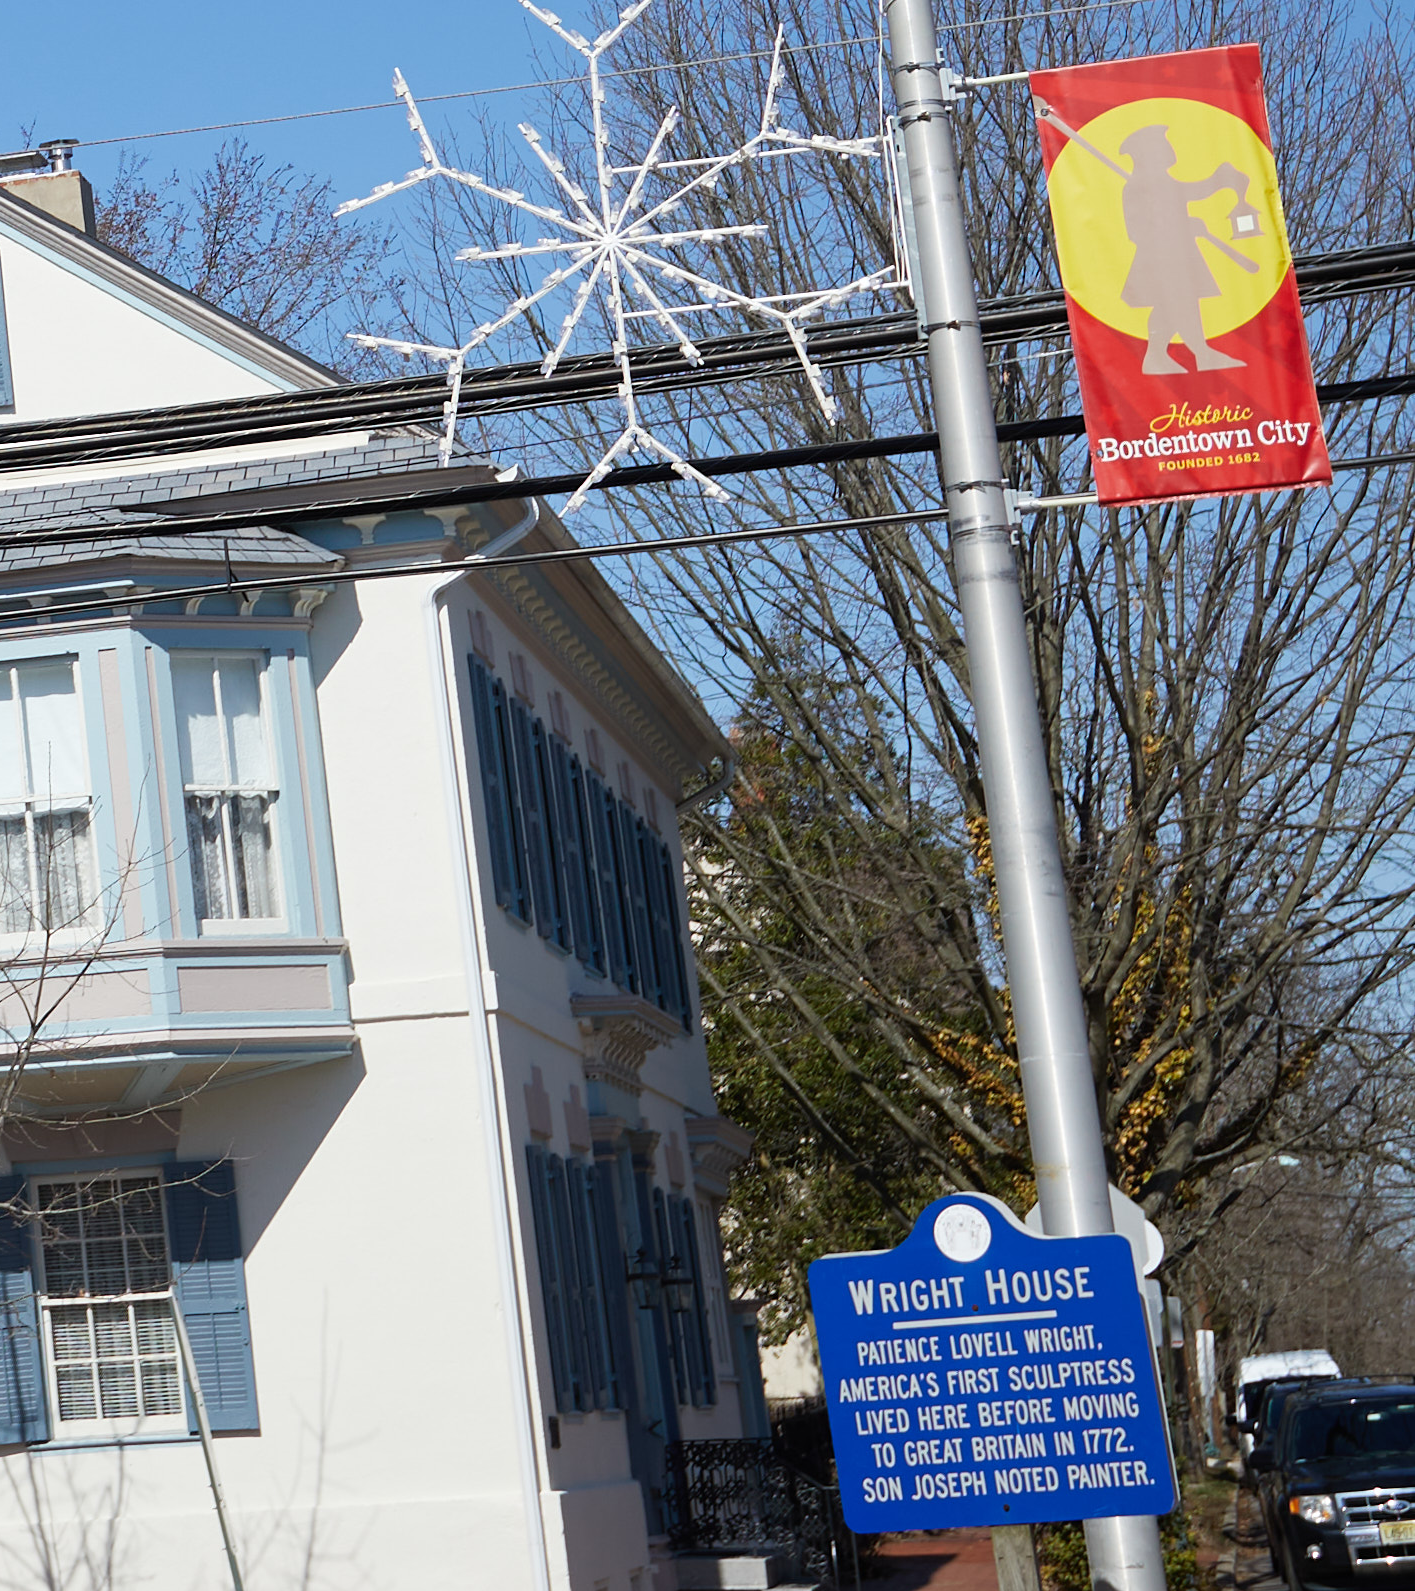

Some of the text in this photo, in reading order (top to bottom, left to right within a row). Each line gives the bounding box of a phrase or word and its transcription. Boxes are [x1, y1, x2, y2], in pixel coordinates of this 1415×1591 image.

[1149, 401, 1254, 433] Historic
[1098, 419, 1311, 462] Bordentown City
[1158, 452, 1261, 472] FOUNDED 1682
[856, 1324, 1103, 1367] PATIENCE LOVELL WRIGHT,
[839, 1357, 1135, 1403] AMERICA'S FIRST SCULPTRESS
[855, 1391, 1140, 1436] LIVED HERE BEFORE MOVING
[870, 1426, 1135, 1468] TO GREAT BRITAIN IN 1772.
[862, 1460, 1155, 1503] SON JOSEPH NOTED PAINTER.
